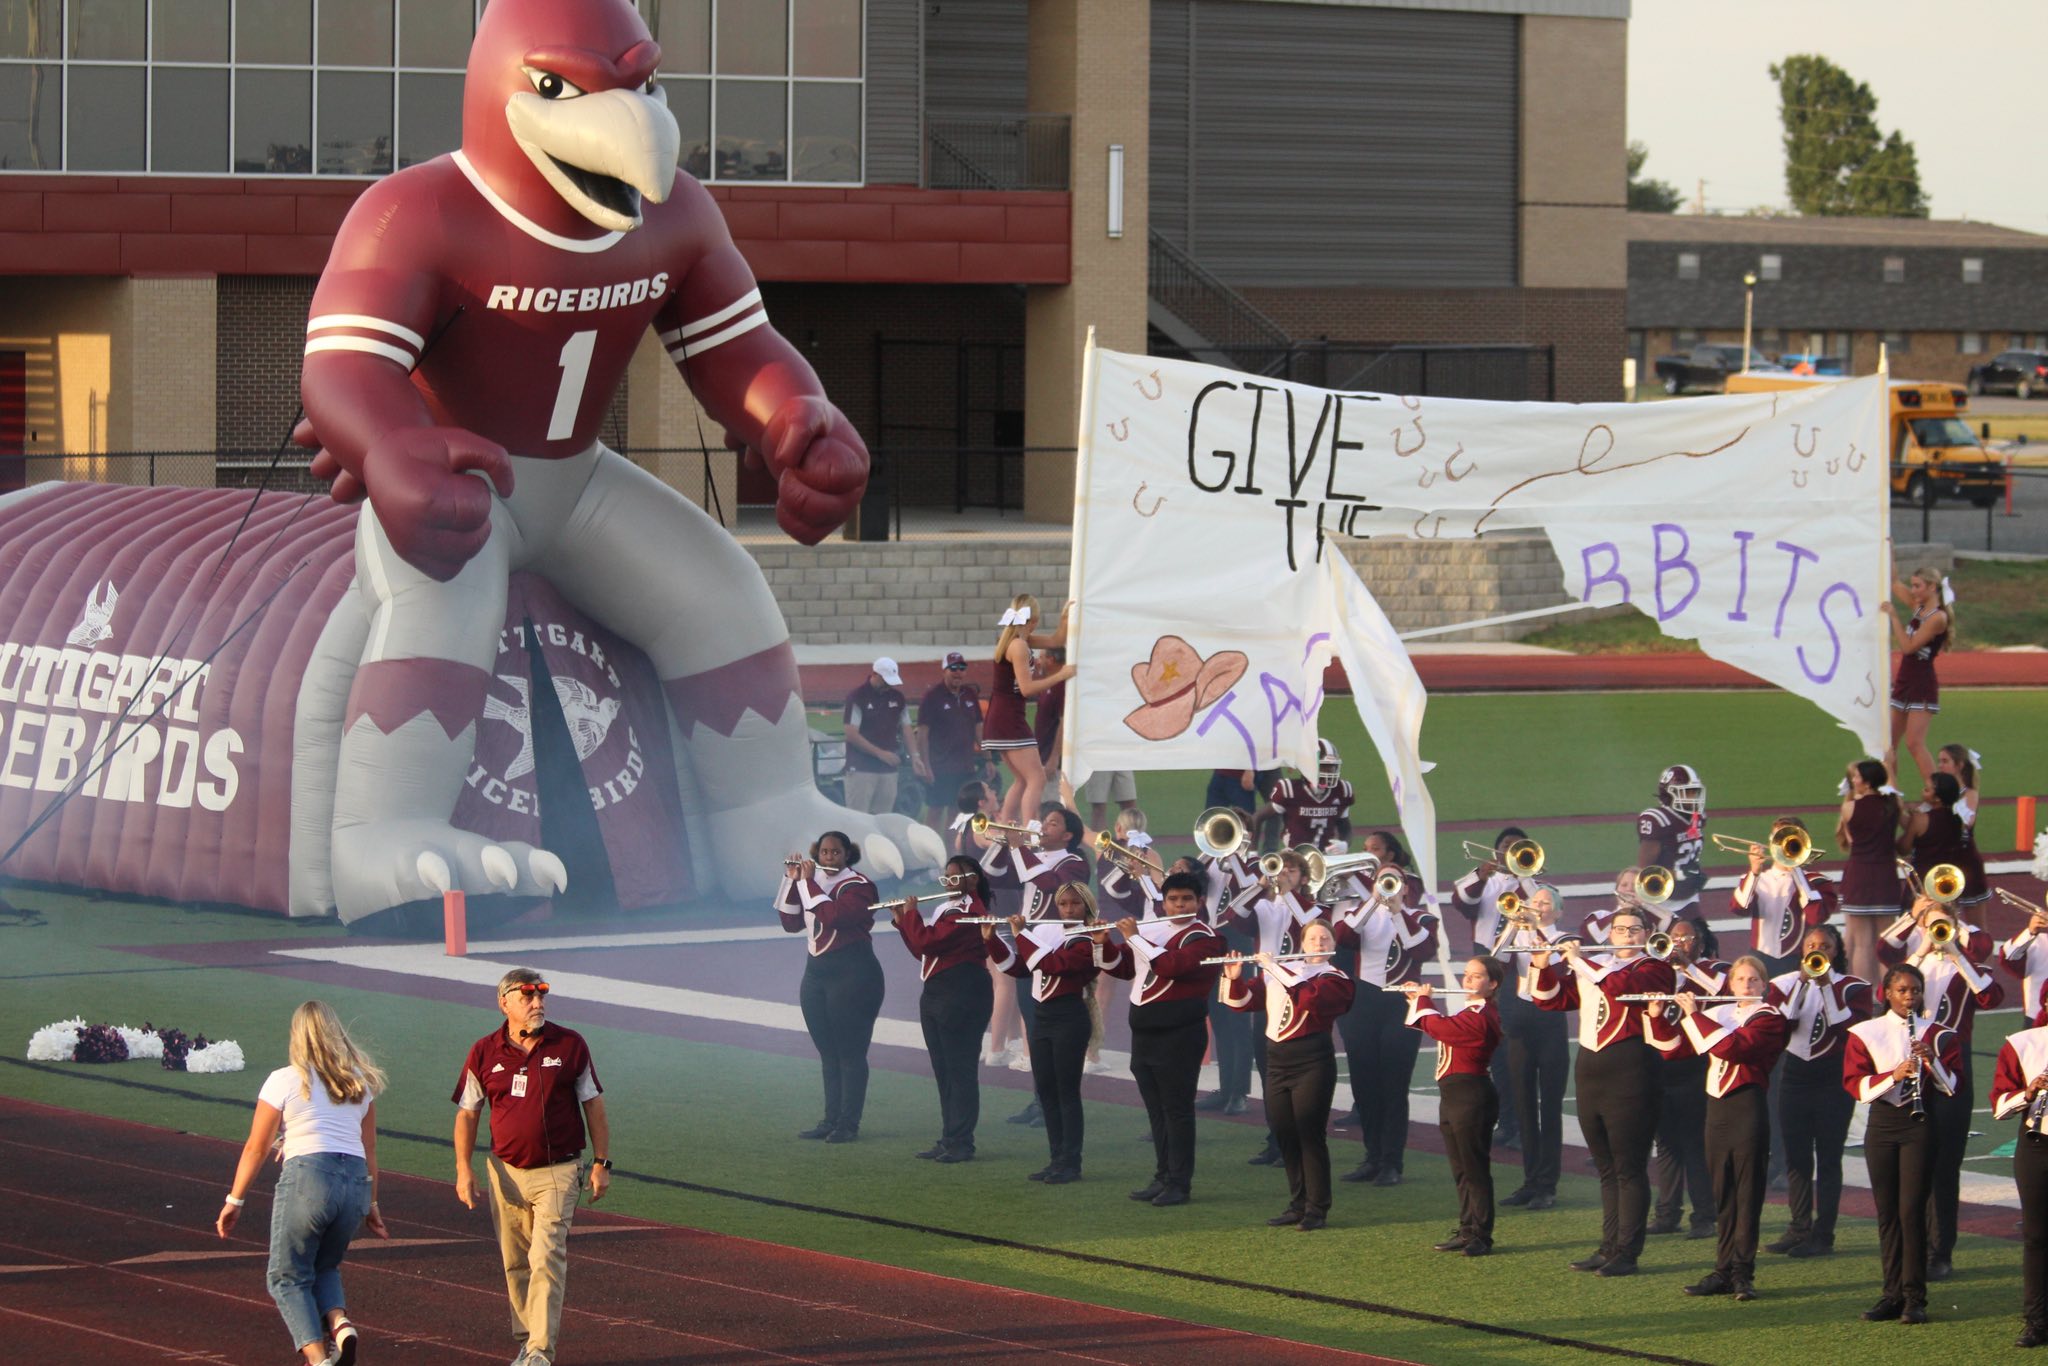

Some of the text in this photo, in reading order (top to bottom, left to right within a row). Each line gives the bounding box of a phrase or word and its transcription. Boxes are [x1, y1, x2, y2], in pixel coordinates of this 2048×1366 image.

[486, 272, 669, 313] RICEBIRDS
[546, 329, 598, 441] 1
[1188, 380, 1381, 502] GIVE
[0, 642, 211, 723] UTTGART
[0, 709, 245, 812] EBIRDS
[465, 725, 644, 817] ICEBIRDS
[1299, 806, 1338, 817] RICEBIRDS
[1640, 820, 1653, 835] 29
